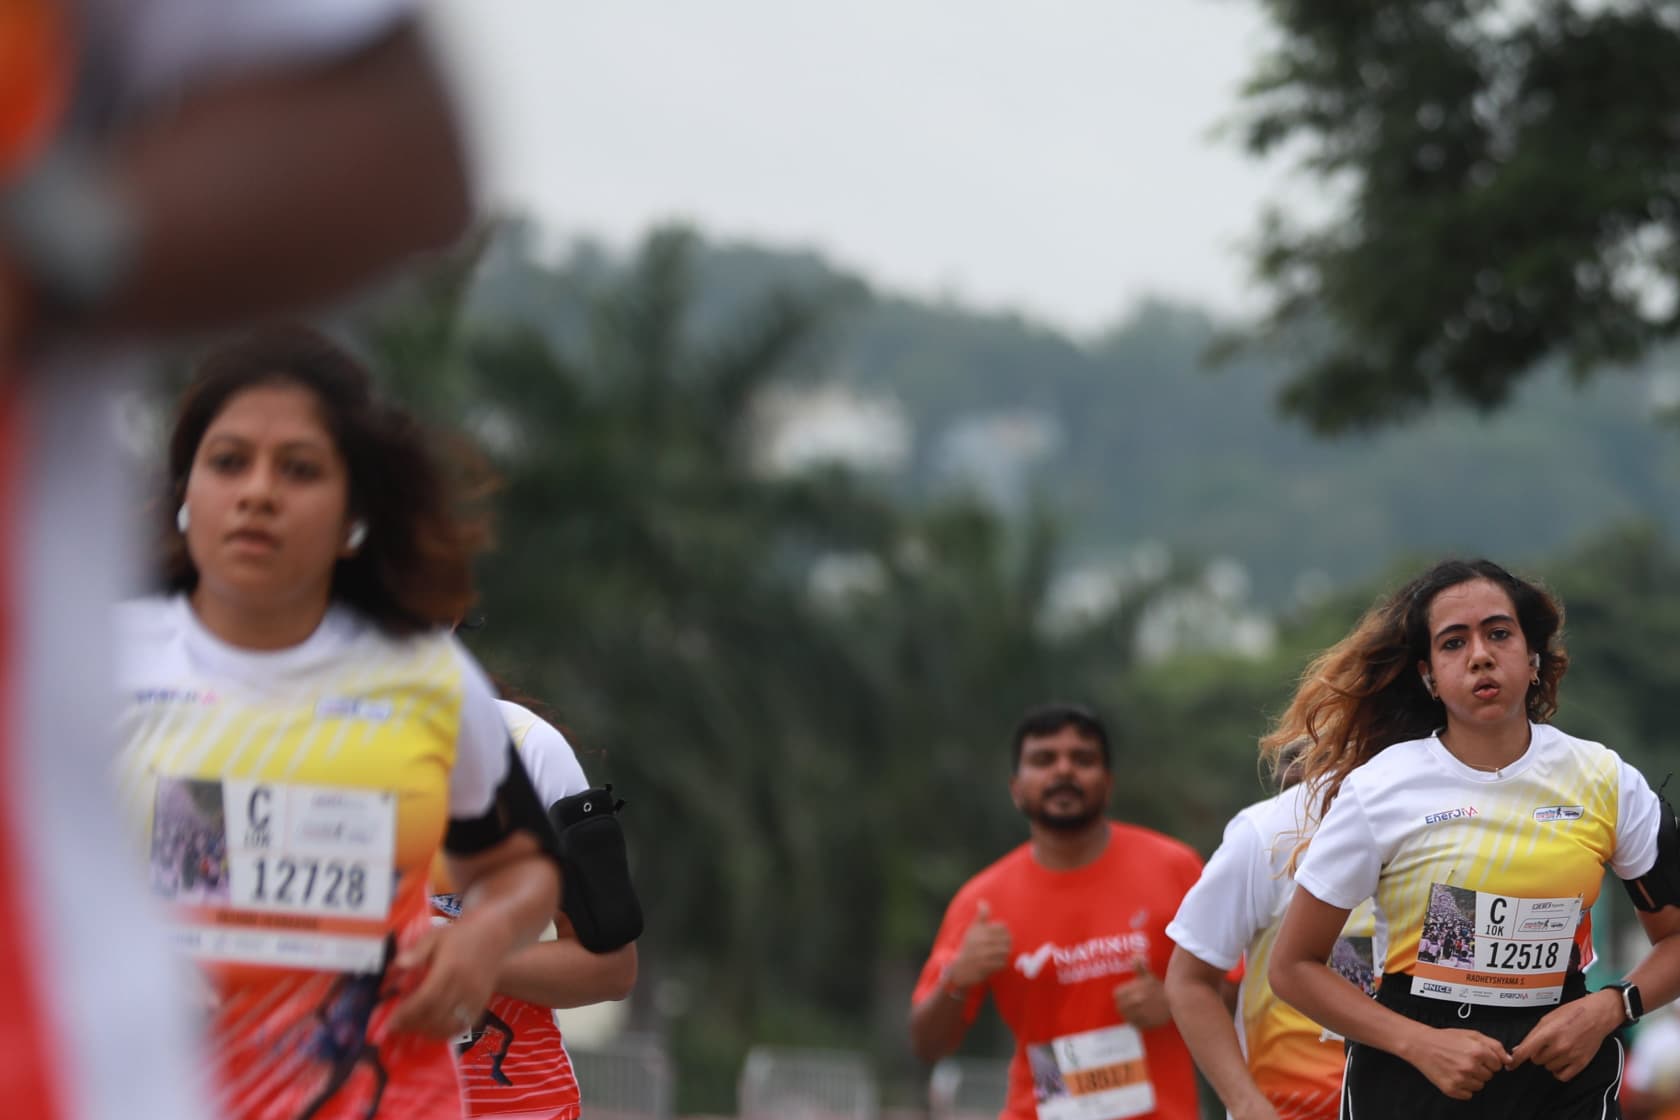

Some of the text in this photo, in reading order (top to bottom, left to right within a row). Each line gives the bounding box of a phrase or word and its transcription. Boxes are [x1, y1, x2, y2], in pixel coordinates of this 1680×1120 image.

[246, 787, 272, 832] C
[254, 858, 367, 908] 12728
[1490, 898, 1508, 924] C
[1485, 924, 1504, 937] 10K
[1486, 942, 1559, 970] 12518
